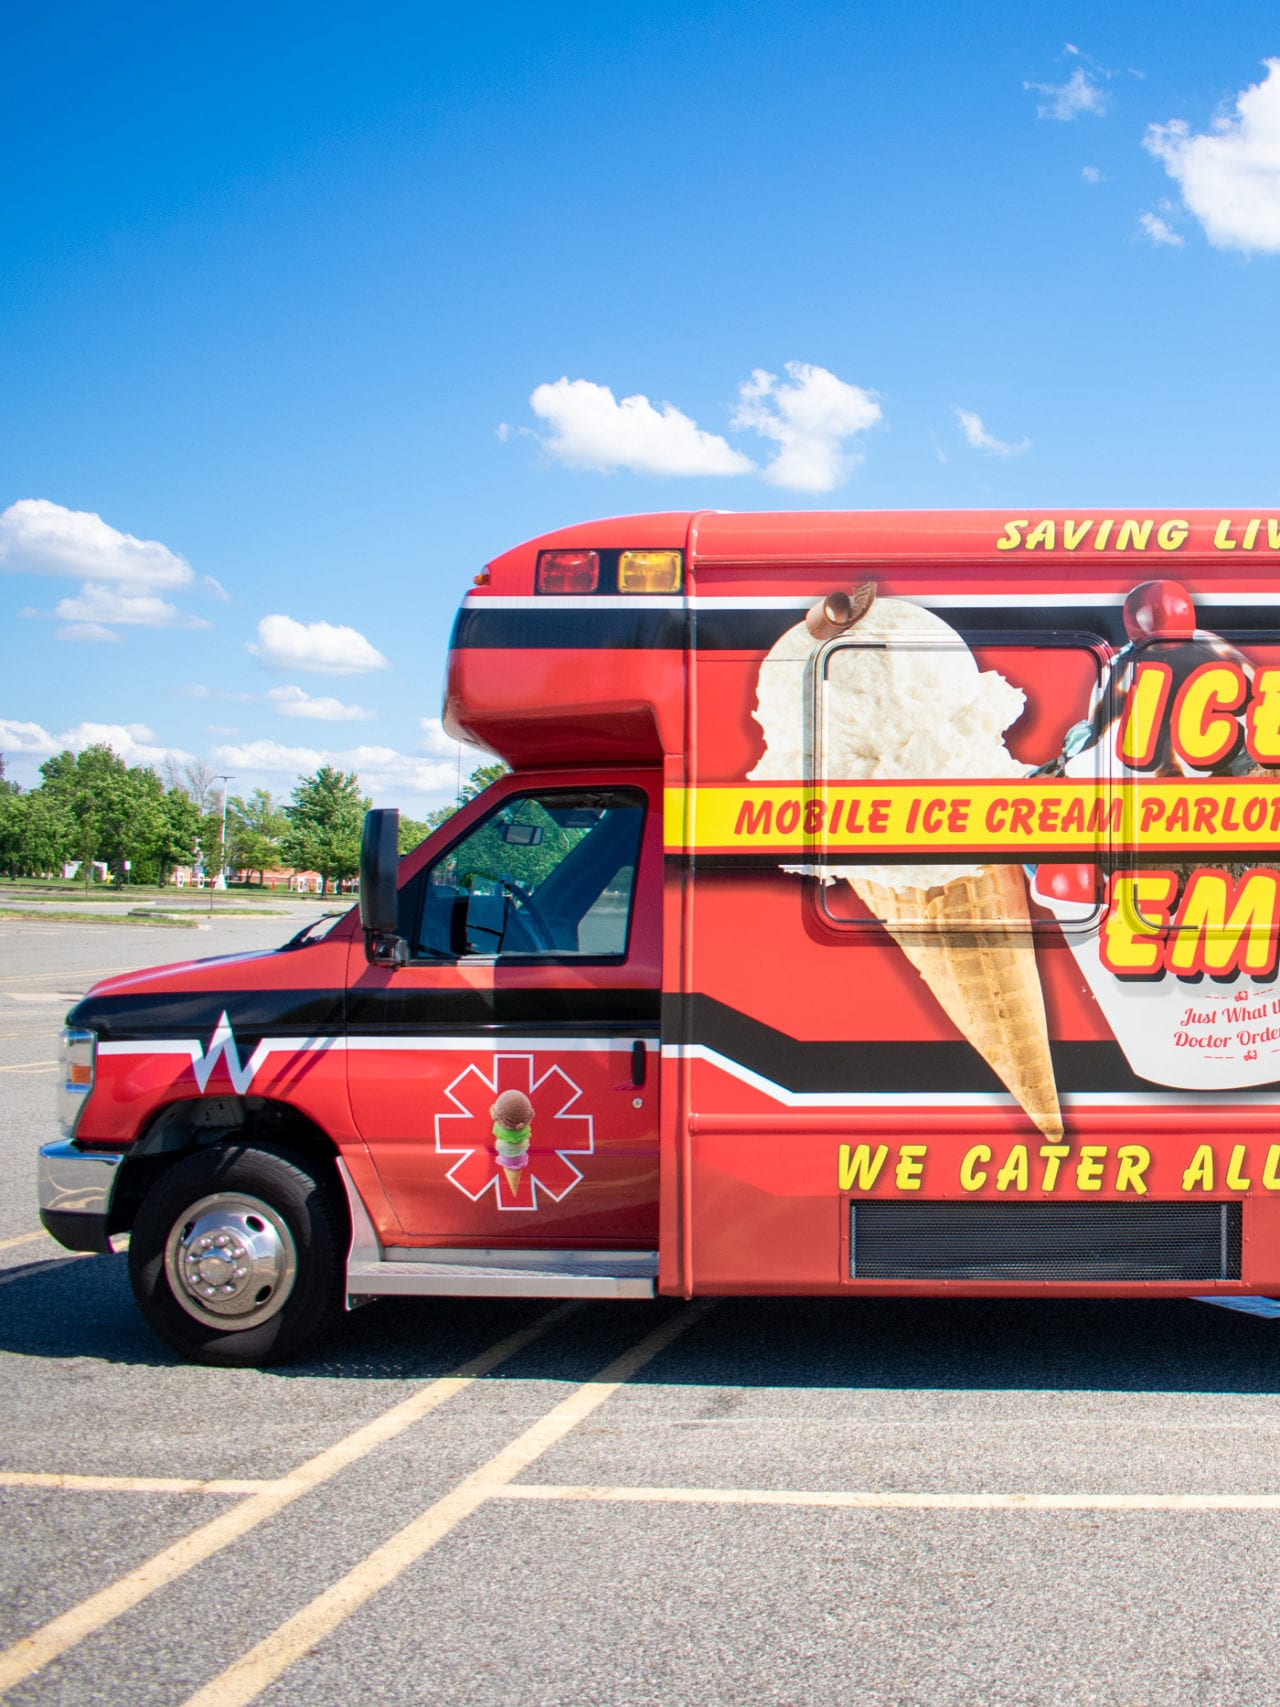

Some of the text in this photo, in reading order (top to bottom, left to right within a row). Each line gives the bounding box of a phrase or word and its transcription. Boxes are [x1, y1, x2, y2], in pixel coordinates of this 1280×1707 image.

[996, 519, 1190, 551] SAVING
[734, 799, 890, 836] MOBILE
[905, 799, 971, 834] ICE
[985, 797, 1123, 834] CREAM
[1180, 1008, 1216, 1026] Just
[1221, 1004, 1267, 1023] What
[1173, 1031, 1232, 1048] Doctor
[838, 1144, 927, 1190] WE
[959, 1144, 1152, 1195] CATER
